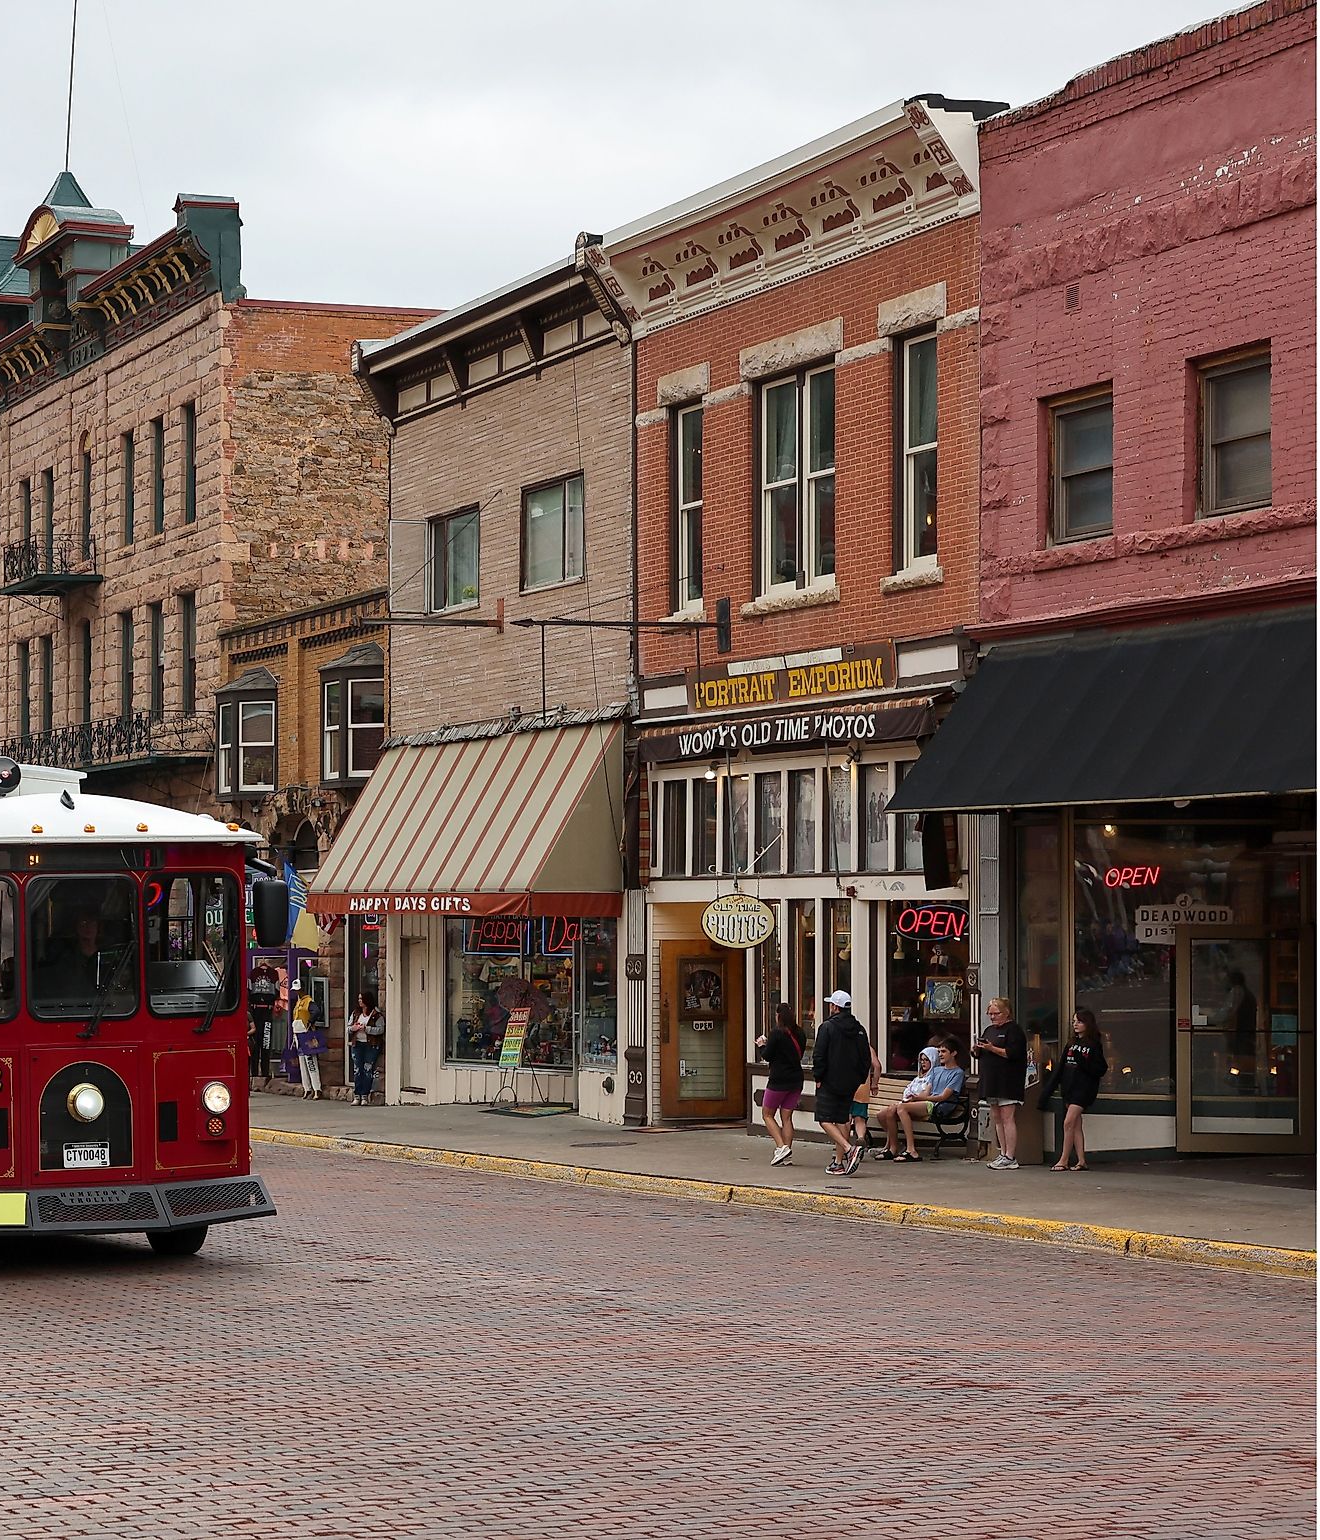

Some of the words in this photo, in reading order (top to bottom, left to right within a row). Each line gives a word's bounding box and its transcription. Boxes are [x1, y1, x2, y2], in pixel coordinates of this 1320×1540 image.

[694, 672, 776, 709] PORTRAIT
[788, 657, 884, 698] EMPORIUM
[741, 720, 772, 747] OLD
[775, 716, 810, 742] TIME
[813, 713, 876, 739] PHOTOS
[1104, 866, 1160, 887] OPEN
[349, 897, 390, 911] HAPPY
[394, 896, 427, 911] DAYS
[430, 896, 471, 912] GIFTS
[712, 903, 733, 912] OLD
[736, 903, 762, 912] TIME
[898, 908, 966, 937] OPEN
[1140, 910, 1229, 922] DEADWOOD
[706, 913, 769, 944] PHOTOS
[694, 1022, 713, 1030] OPEN
[66, 1148, 106, 1162] CTY0048
[60, 1189, 127, 1198] HOMETOWN
[69, 1196, 121, 1204] TROLLEY
